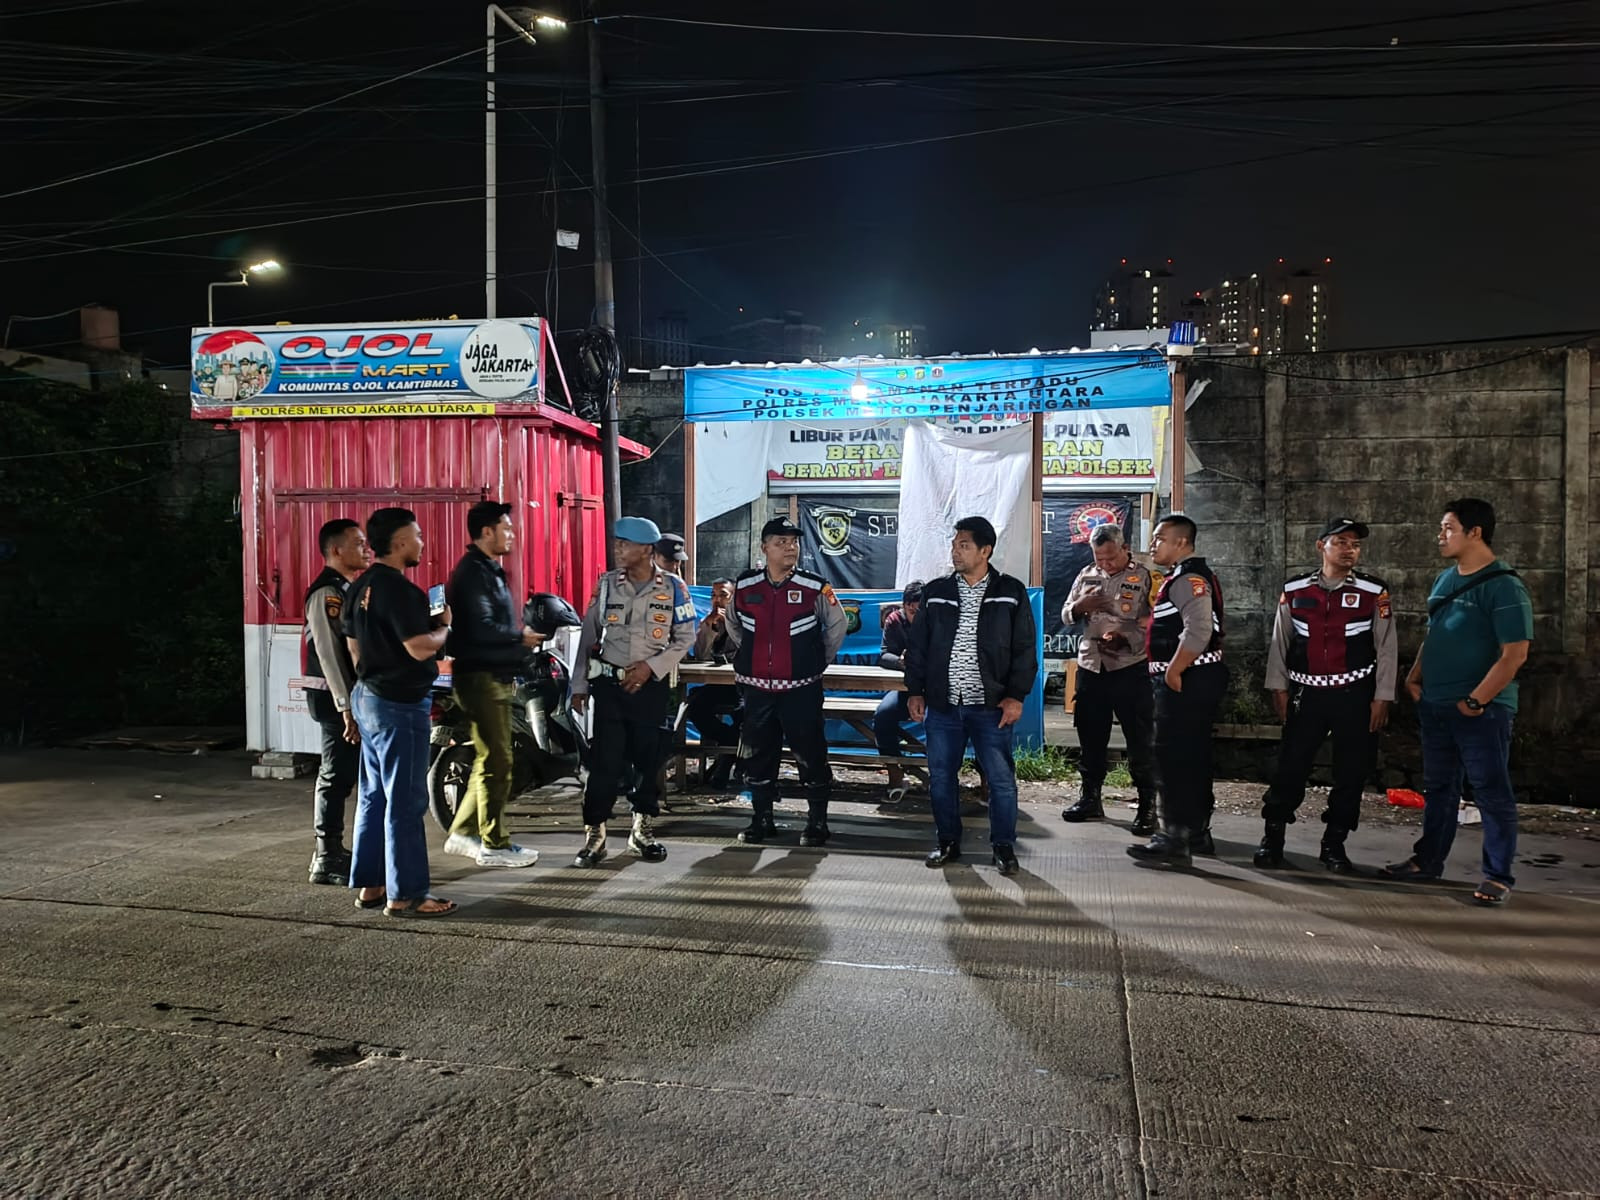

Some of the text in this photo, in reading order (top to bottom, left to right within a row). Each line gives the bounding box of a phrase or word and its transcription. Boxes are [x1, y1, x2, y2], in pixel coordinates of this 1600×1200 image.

[280, 333, 444, 360] OJOL
[465, 344, 498, 359] JAGA
[362, 363, 450, 377] MART
[279, 379, 459, 392] KOMUNITAS OJOL KAMTIBMAS
[764, 388, 803, 397] POS
[976, 376, 1078, 391] TERPADU
[743, 397, 822, 409] POLRES
[1029, 386, 1105, 399] UTARA
[252, 404, 475, 416] POLRES METRO JAKARTA UTARA
[754, 407, 833, 419] POLSEK
[929, 398, 1091, 413] PENJARINGAN
[790, 429, 843, 442] LIBUR
[1055, 424, 1130, 437] PUASA
[783, 463, 873, 478] BERARTI
